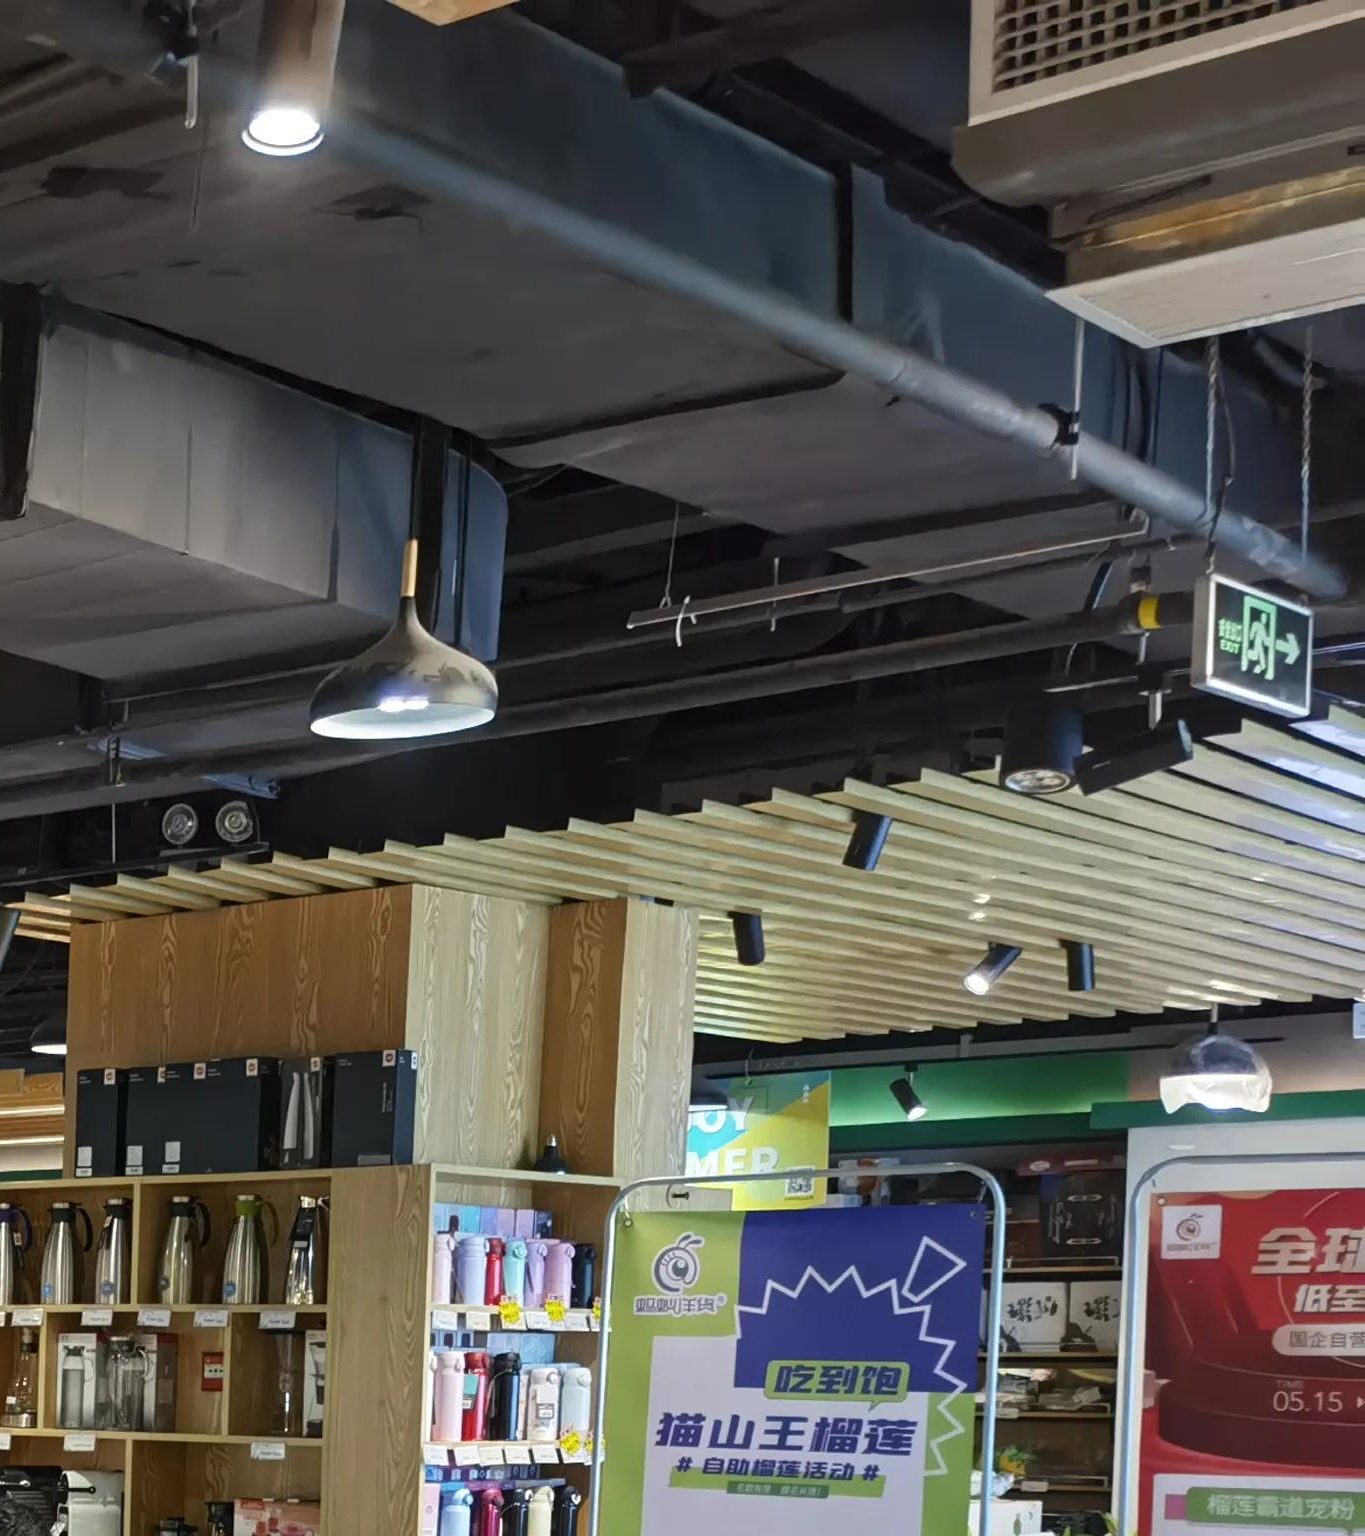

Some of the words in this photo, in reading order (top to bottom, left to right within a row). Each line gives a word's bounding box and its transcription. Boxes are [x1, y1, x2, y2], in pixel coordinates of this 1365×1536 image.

[1289, 1331, 1365, 1348] 国企自营
[774, 1365, 902, 1396] 吃到饱
[1273, 1391, 1344, 1413] 05.15
[654, 1411, 918, 1456] 猫山王榴莲
[677, 1457, 693, 1473] #
[702, 1458, 856, 1481] 自助榴莲活动
[862, 1465, 880, 1481] #
[1206, 1493, 1355, 1520] 榴莲霸道宠粉
